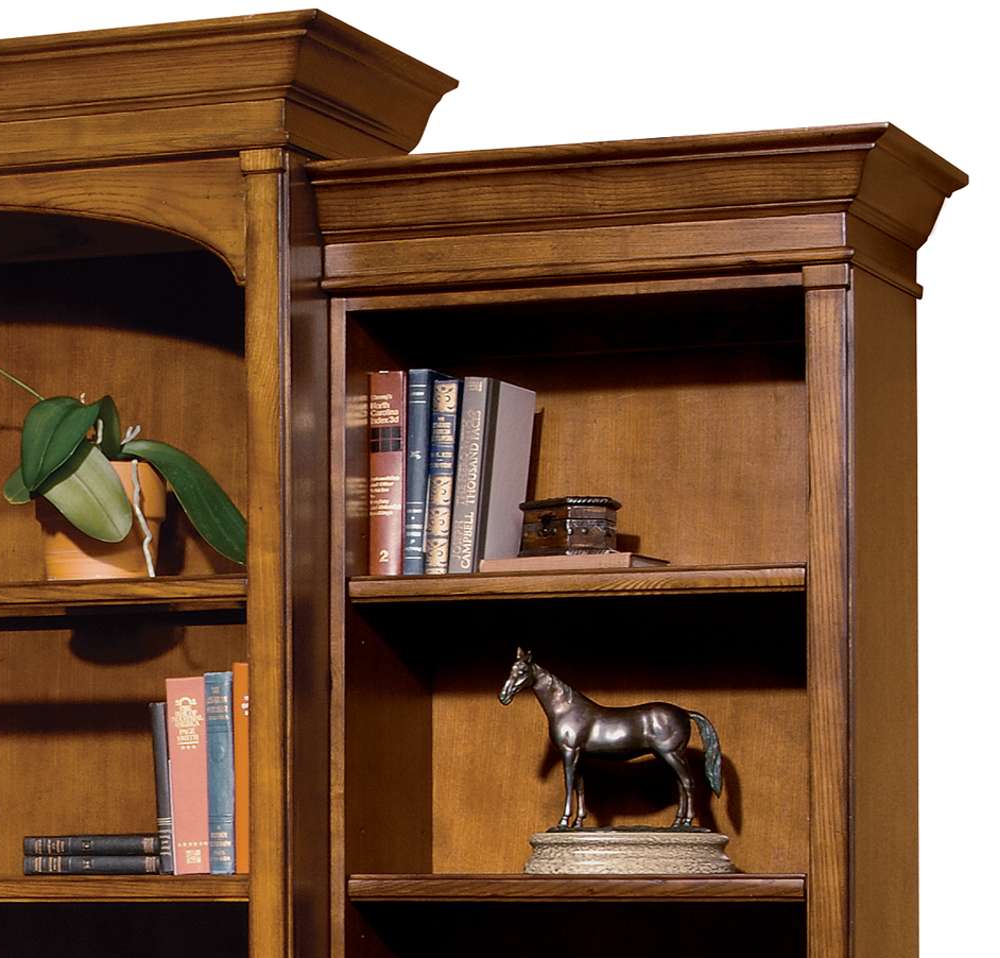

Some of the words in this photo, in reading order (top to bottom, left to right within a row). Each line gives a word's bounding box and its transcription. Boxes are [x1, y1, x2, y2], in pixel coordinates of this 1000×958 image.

[467, 442, 480, 504] THOUSAND
[379, 549, 390, 563] 2
[460, 511, 475, 569] CAMPBELL
